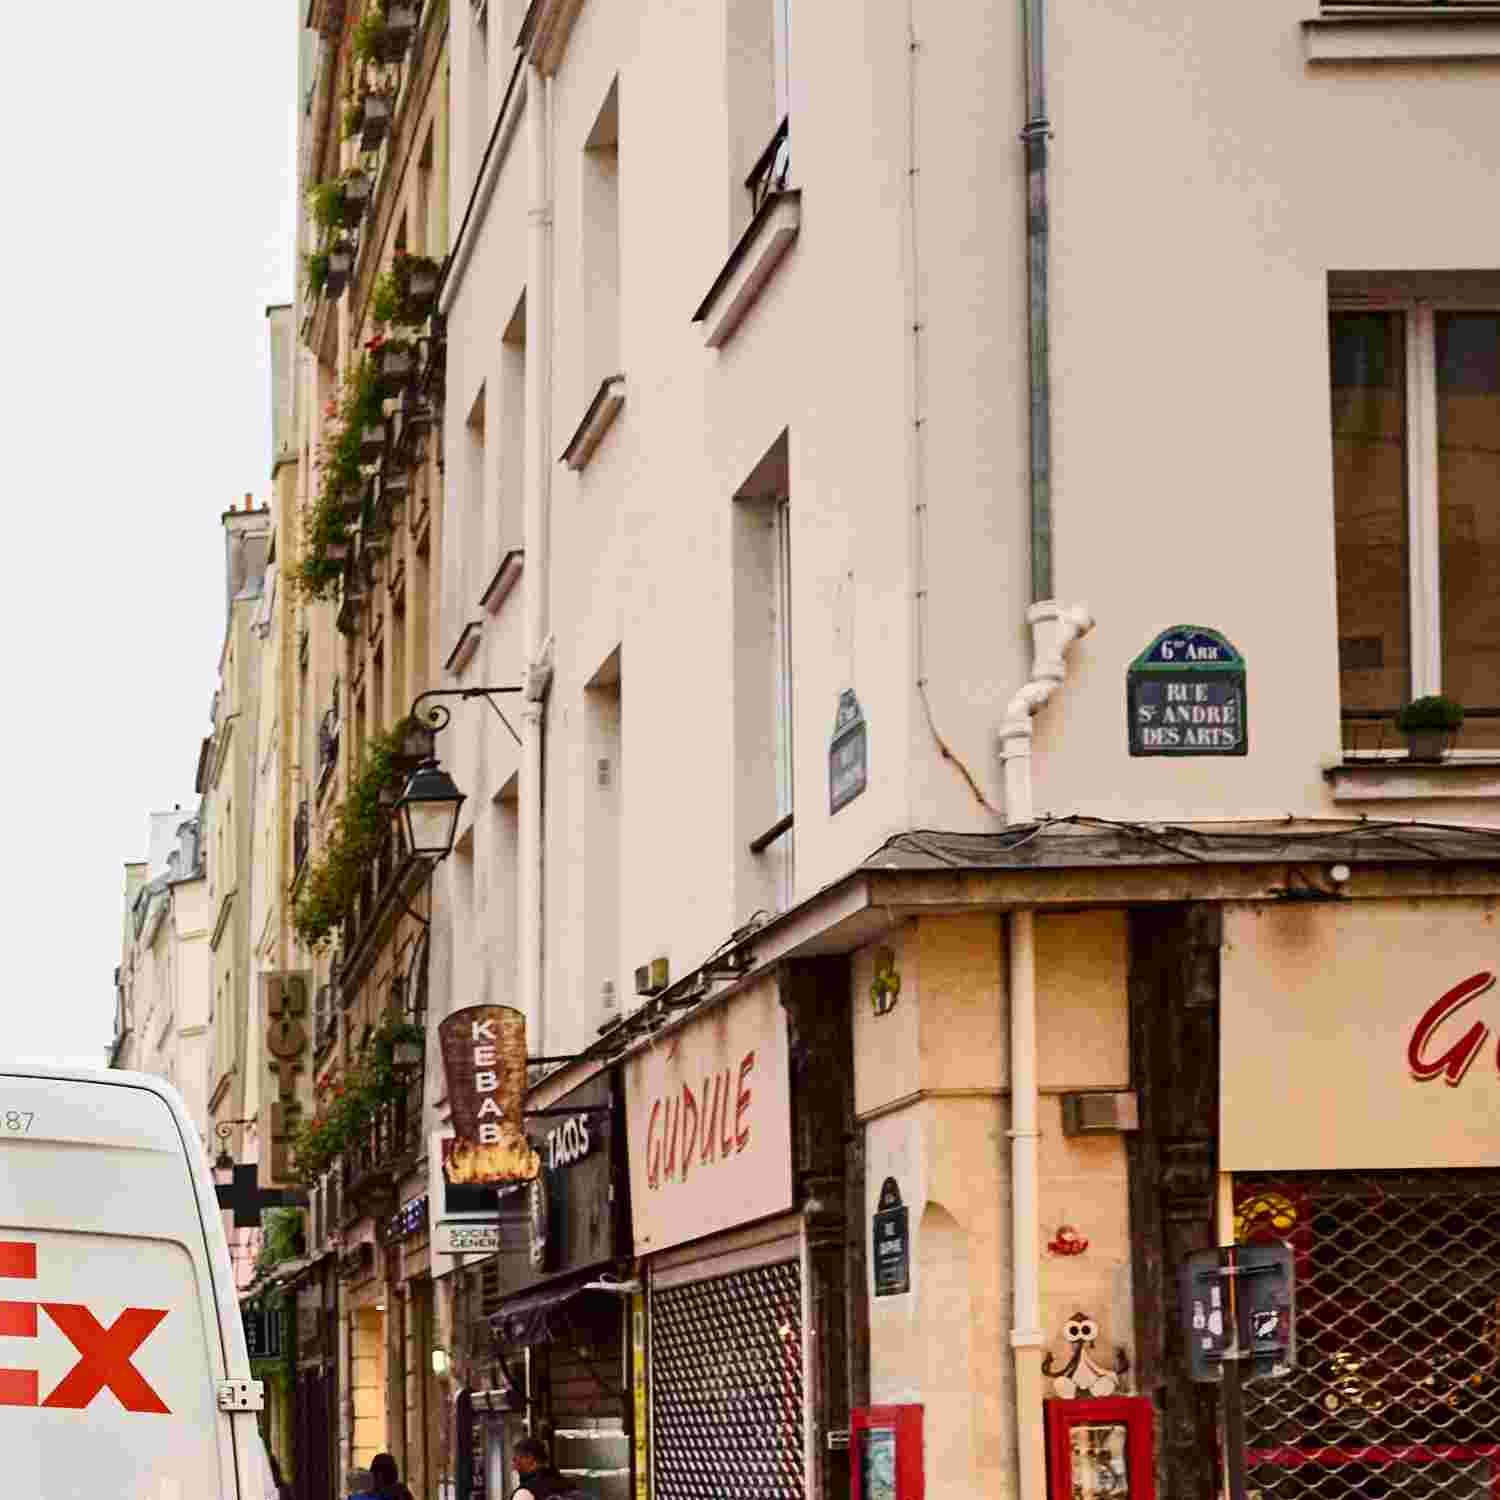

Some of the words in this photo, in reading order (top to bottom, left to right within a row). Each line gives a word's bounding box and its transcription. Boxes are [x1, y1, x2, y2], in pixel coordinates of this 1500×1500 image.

[1162, 697, 1236, 723] ANDRÉ
[1167, 683, 1209, 702] RUE
[1143, 728, 1180, 745] DES
[1183, 728, 1235, 745] ARTS
[1408, 971, 1500, 1088] G
[472, 1021, 504, 1144] KEBAB
[547, 1112, 591, 1169] TACOS
[646, 1050, 756, 1190] GUDULE
